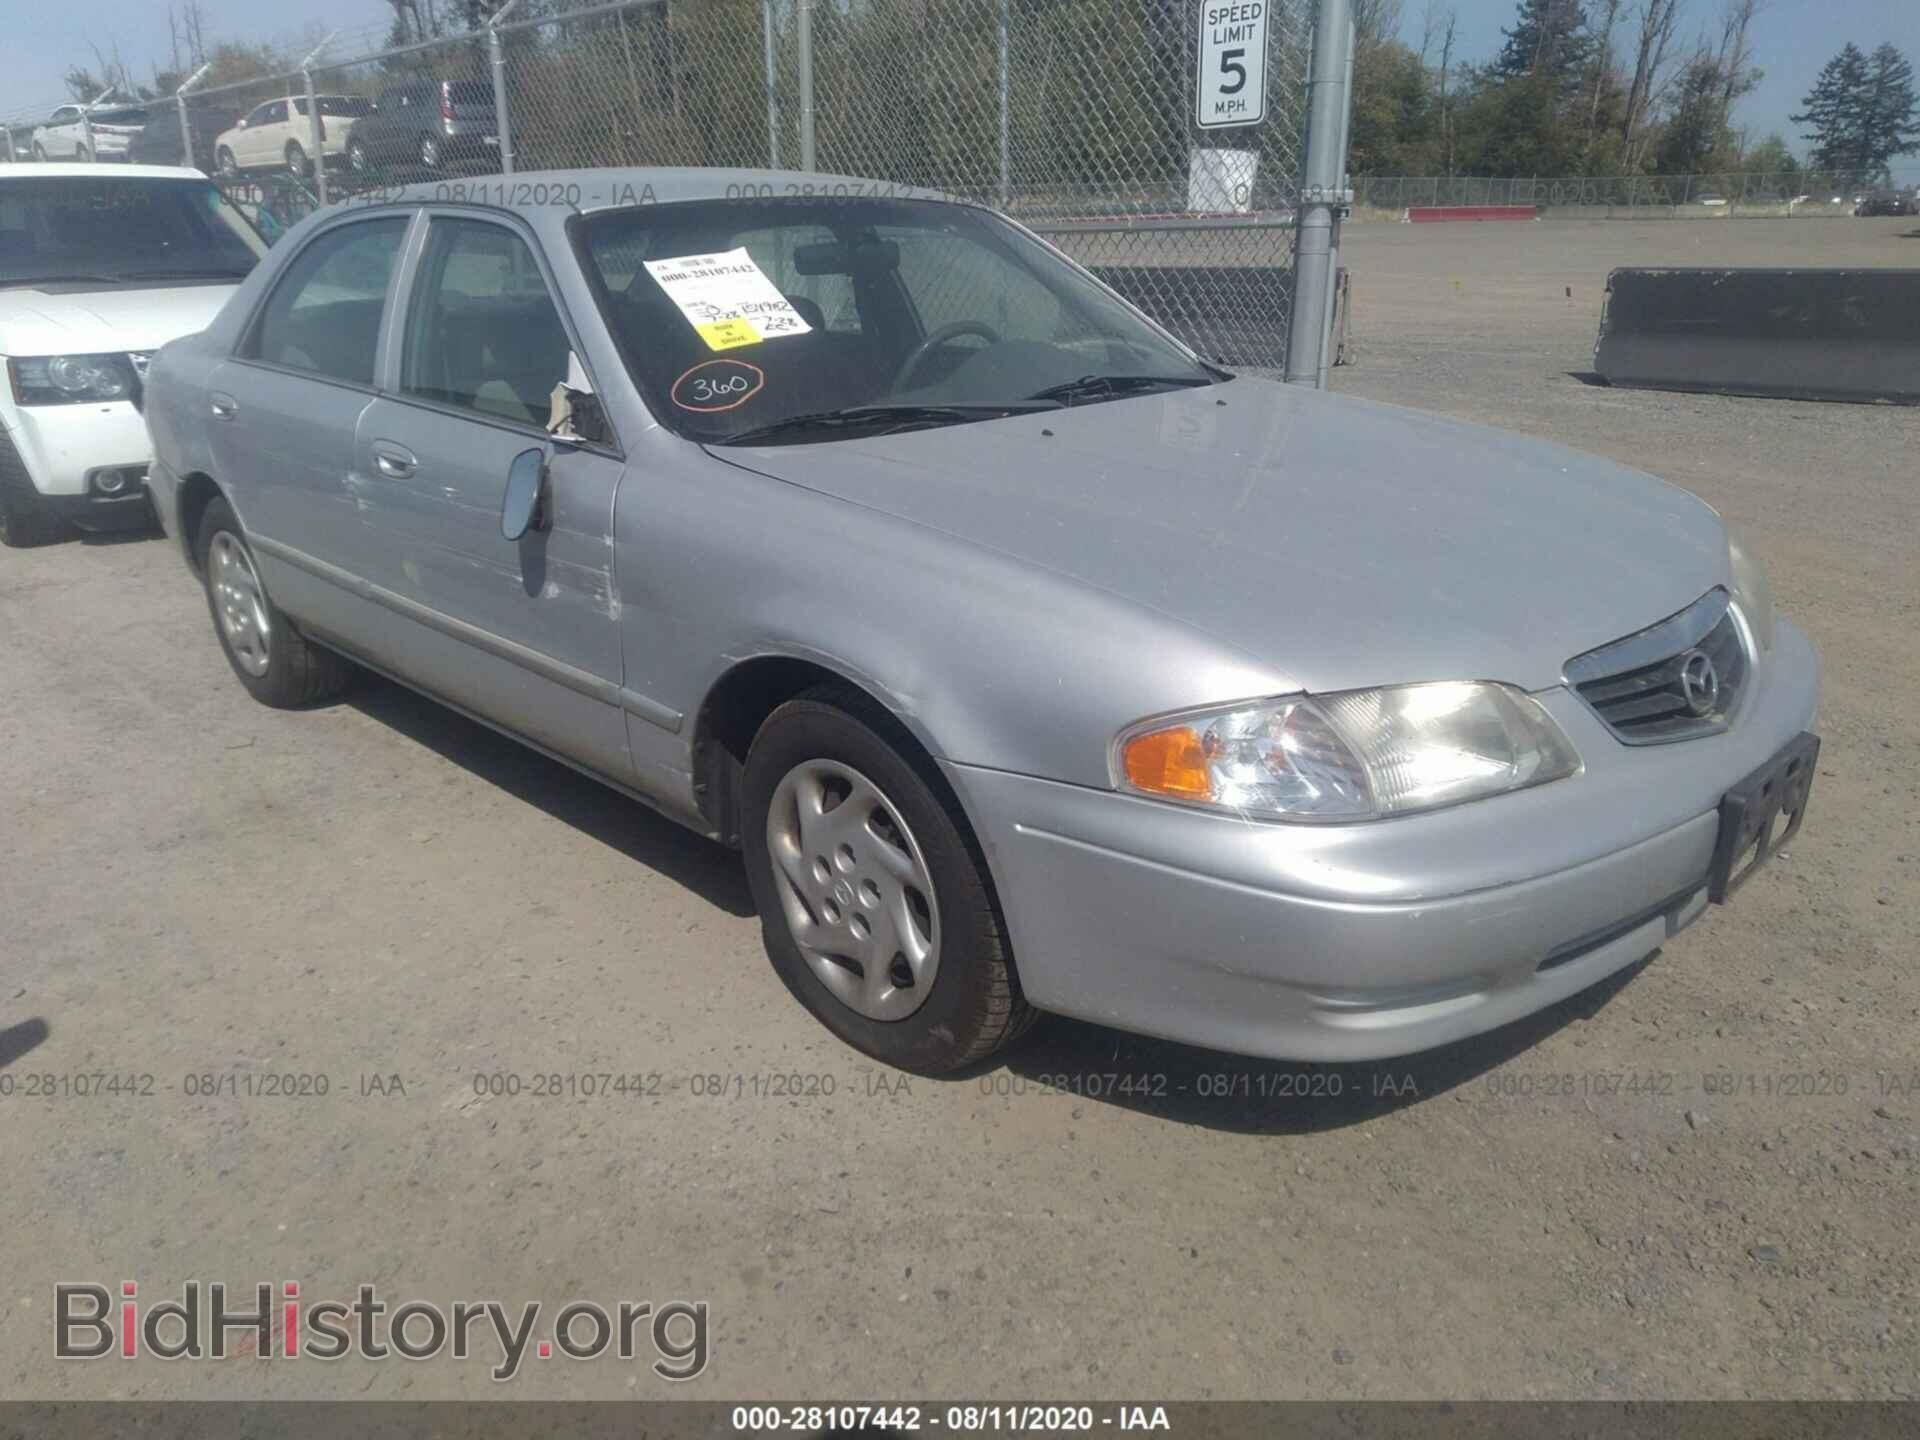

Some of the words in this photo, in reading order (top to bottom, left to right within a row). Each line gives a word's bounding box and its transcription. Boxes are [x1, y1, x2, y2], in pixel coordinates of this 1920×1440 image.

[1208, 3, 1262, 25] SPEED
[1213, 24, 1256, 45] LIMIT
[1219, 48, 1247, 95] 5
[694, 376, 748, 401] 360
